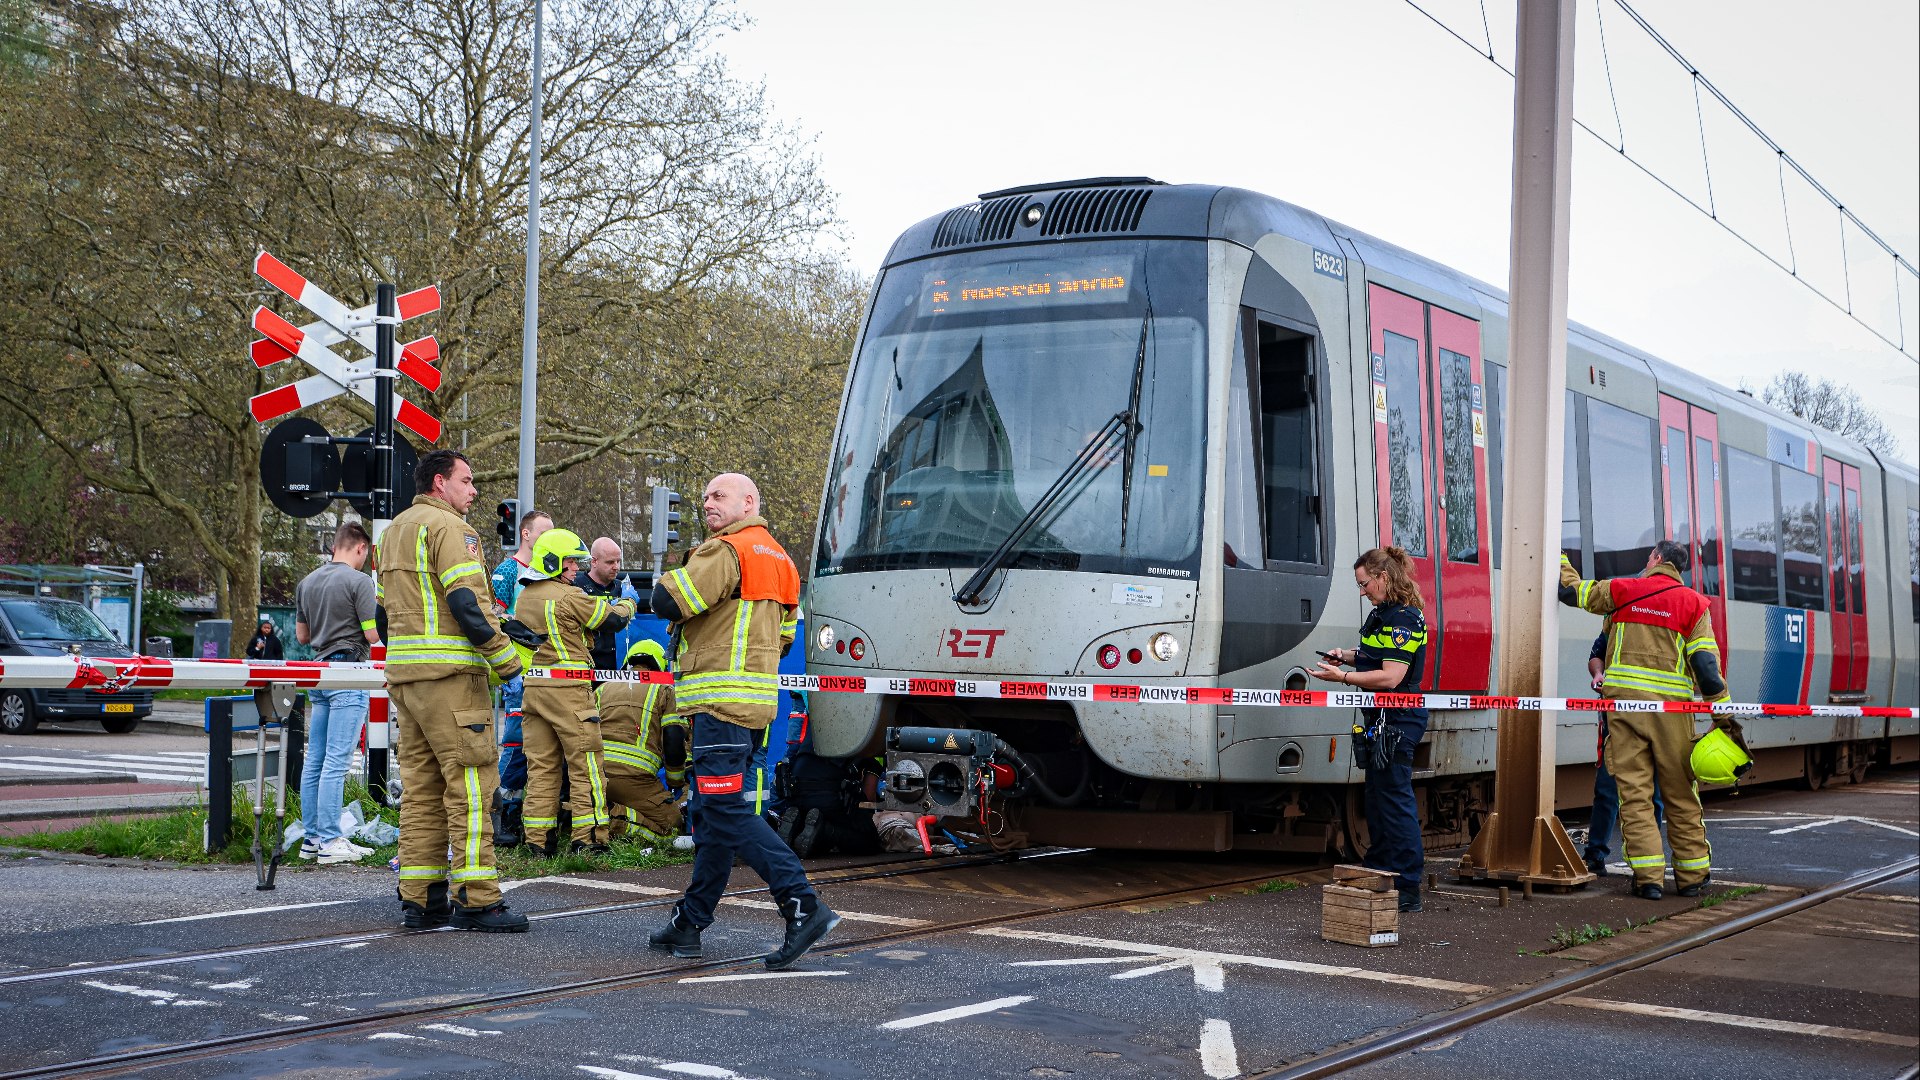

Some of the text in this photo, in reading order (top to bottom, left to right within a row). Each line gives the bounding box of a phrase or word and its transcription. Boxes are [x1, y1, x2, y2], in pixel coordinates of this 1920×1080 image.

[1314, 250, 1343, 277] 5623
[1147, 566, 1191, 578] BOMBARDIER
[1631, 605, 1672, 618] Bevelvoerder
[1785, 613, 1804, 643] RET
[937, 628, 1006, 659] RET
[565, 669, 651, 682] BRANDWEER
[780, 676, 867, 690] BRANDWEER
[889, 679, 976, 694] BRANDWEER
[999, 683, 1087, 698] BRANDWEER
[1110, 686, 1199, 702] BRANDWEER
[1222, 690, 1312, 705] BRANDWEER
[1335, 694, 1426, 708] BRANDWEER
[1450, 697, 1541, 710] BRANDWEER
